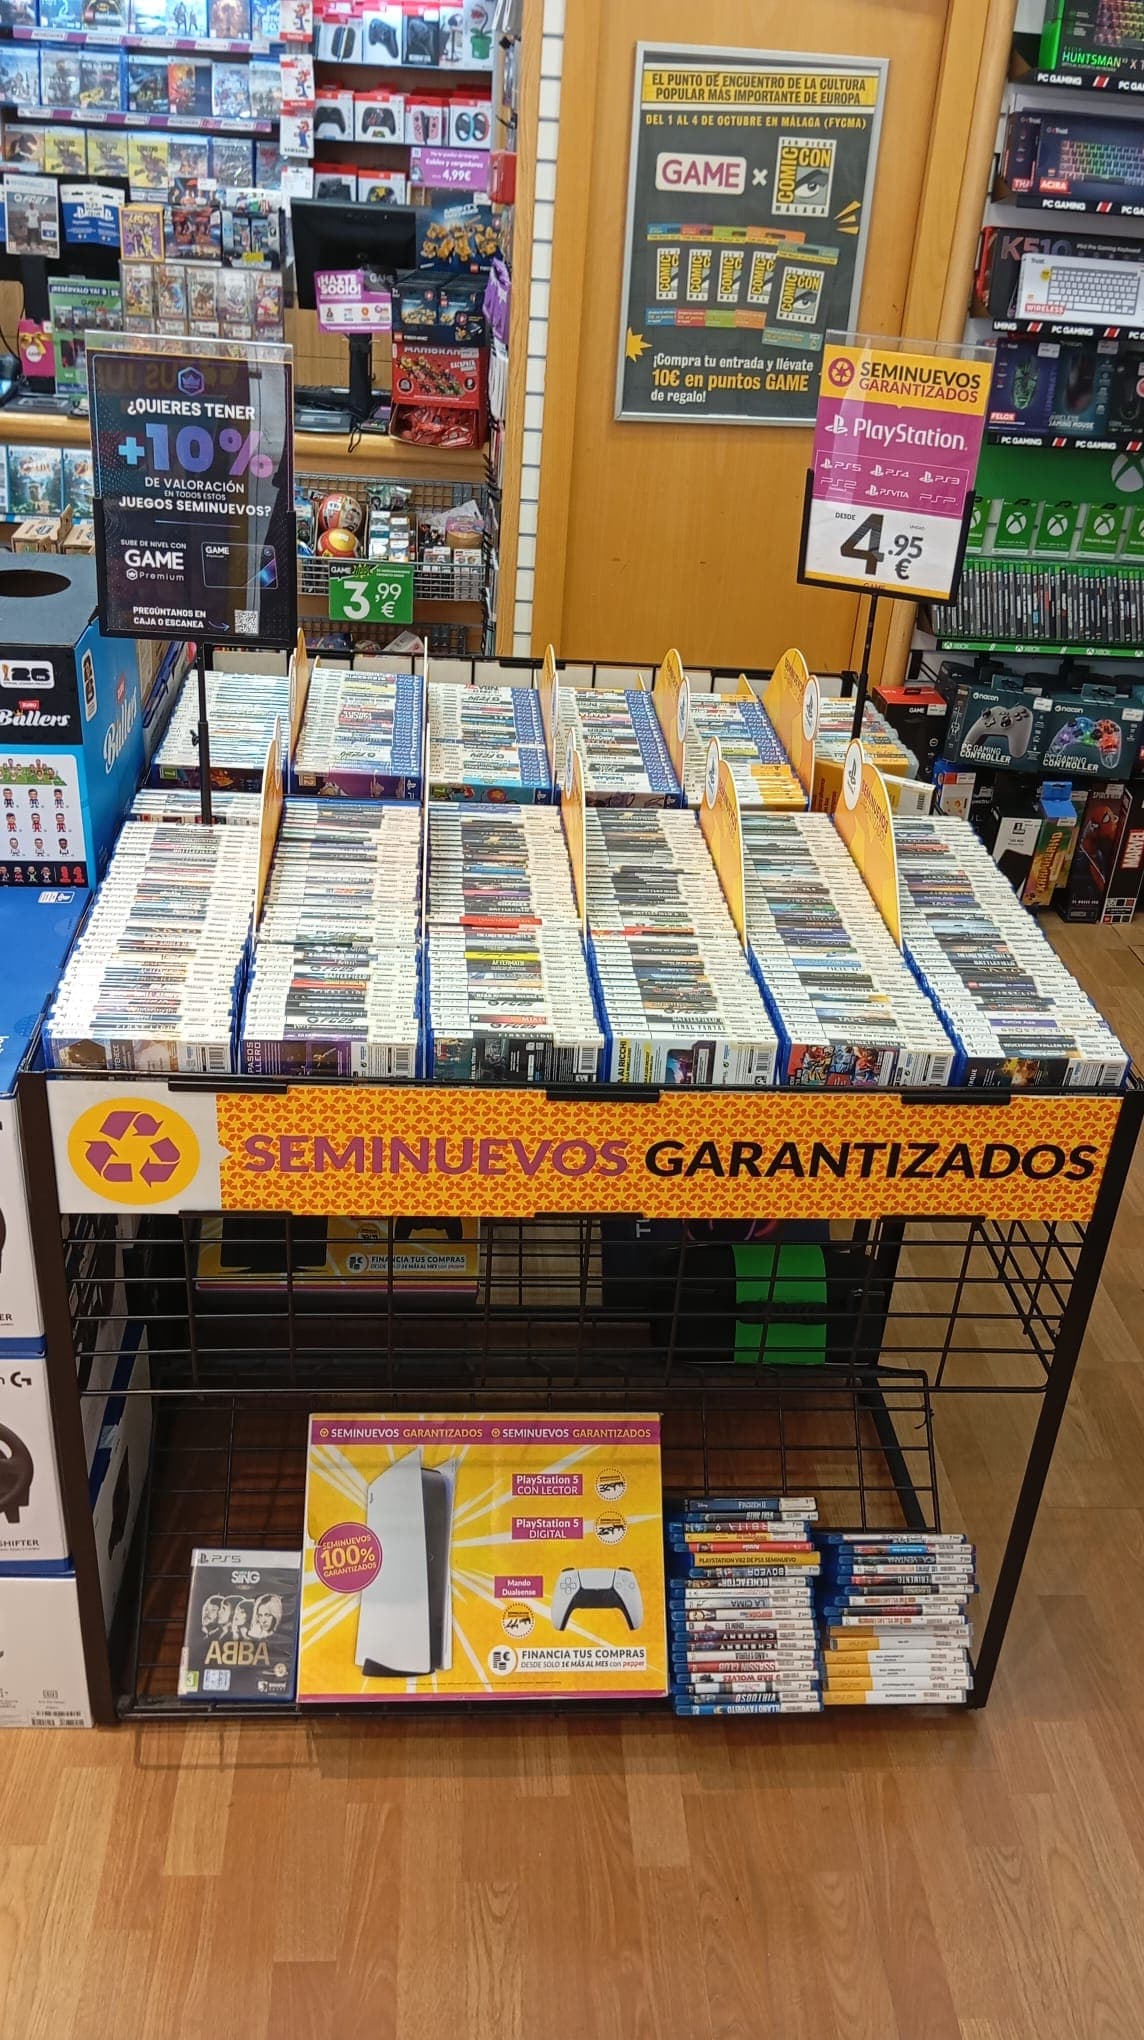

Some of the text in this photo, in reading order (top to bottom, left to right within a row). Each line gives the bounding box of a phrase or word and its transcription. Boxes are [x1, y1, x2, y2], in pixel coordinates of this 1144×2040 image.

[1061, 50, 1122, 68] HUNTSMAN
[652, 73, 866, 91] EL PUNTO DE ENCUENTRO DE LA CULTURA
[1037, 72, 1129, 90] PC GAMING PC
[655, 87, 861, 105] POPULAR MÁS IMPORTANTE DE EUROPA
[645, 114, 867, 130] DEL 1 AL 4 DE OCTUBRE EN MÁLAGA (FYCMA)
[799, 148, 831, 167] CON
[442, 169, 472, 182] 4,99€
[661, 146, 799, 204] GAME COMIC
[1042, 199, 1132, 215] PC GAMING PC
[659, 254, 672, 292] COMIC
[690, 255, 703, 293] COMIC
[720, 256, 734, 294] COMIC
[751, 256, 766, 295] COMIC
[319, 283, 362, 296] SOCIO!
[797, 275, 820, 290] CON
[781, 274, 798, 312] COMIC
[1025, 304, 1065, 314] WIRELESS
[1051, 324, 1139, 340] PC GAMING PC
[653, 353, 814, 373] ¡Compra tu entrada y llévate
[652, 369, 809, 392] 10€ en puntos GAME
[860, 361, 982, 390] SEMINUEVOS
[650, 390, 707, 405] de regalo!
[858, 377, 979, 404] GARANTIZADOS
[127, 398, 256, 421] ¿QUIERES TENER
[852, 417, 967, 451] PlayStation
[118, 421, 274, 480] +10%
[1001, 435, 1117, 451] PC GAMING PC GAMING
[834, 460, 960, 486] PS5 PS4 PS3
[144, 476, 245, 494] DE VALORACIÓN
[820, 477, 857, 493] PS2
[164, 489, 226, 501] EN TODOS ESTOS
[118, 495, 272, 518] JUEGOS SEMINUEVOS?
[834, 511, 857, 521] DESDE
[120, 538, 187, 550] SUBE DE NIVEL CON
[205, 545, 230, 556] GAME
[839, 513, 886, 577] 4
[895, 558, 912, 581] €
[124, 549, 185, 571] GAME
[138, 570, 185, 582] Premium
[330, 566, 352, 575] GAME
[342, 580, 371, 620] 3
[380, 600, 396, 618] €
[132, 604, 206, 618] PREGÚNTANOS EN
[133, 616, 205, 629] CAJA O ESCANEA
[978, 693, 1000, 703] nacon
[0, 708, 71, 727] Ballers
[908, 706, 926, 715] GAME
[1061, 705, 1084, 714] nacon
[961, 743, 1002, 755] PC GAMING
[959, 750, 1012, 765] CONTROLLER
[1056, 754, 1087, 764] GAMING
[1042, 759, 1099, 773] CONTROLLER
[246, 1041, 255, 1074] PASOS
[244, 1131, 1098, 1182] SEMINUEVOS GARANTIZADOS
[410, 1255, 426, 1263] TUS
[330, 1427, 652, 1439] SEMINUEVOS GARANTIZADOS SEMINUEVOS GARANTIZADOS
[516, 1474, 579, 1486] PlayStation 5
[516, 1485, 578, 1495] CON LECTOR
[515, 1518, 580, 1529] PlayStation 5
[321, 1533, 372, 1551] SEMINUEVOS
[529, 1529, 567, 1540] DIGITAL
[211, 1554, 242, 1564] PS5
[320, 1543, 376, 1571] 100%
[698, 1556, 735, 1565] PLAYSTATION
[764, 1556, 797, 1564] SEMINUEVO
[323, 1561, 377, 1578] GARANTIZADOS
[507, 1578, 531, 1587] Mando
[501, 1588, 537, 1597] Dualsense
[730, 1600, 766, 1608] LA CIMA
[204, 1640, 270, 1666] ABBA
[521, 1649, 645, 1660] FINANCIA TUS COMPRAS
[520, 1660, 543, 1669] DESDE
[570, 1660, 586, 1668] MÁS
[594, 1660, 609, 1668] MES
[622, 1661, 645, 1669] pepper
[740, 1662, 776, 1672] SSASSIN
[722, 1674, 755, 1682] WOLVES
